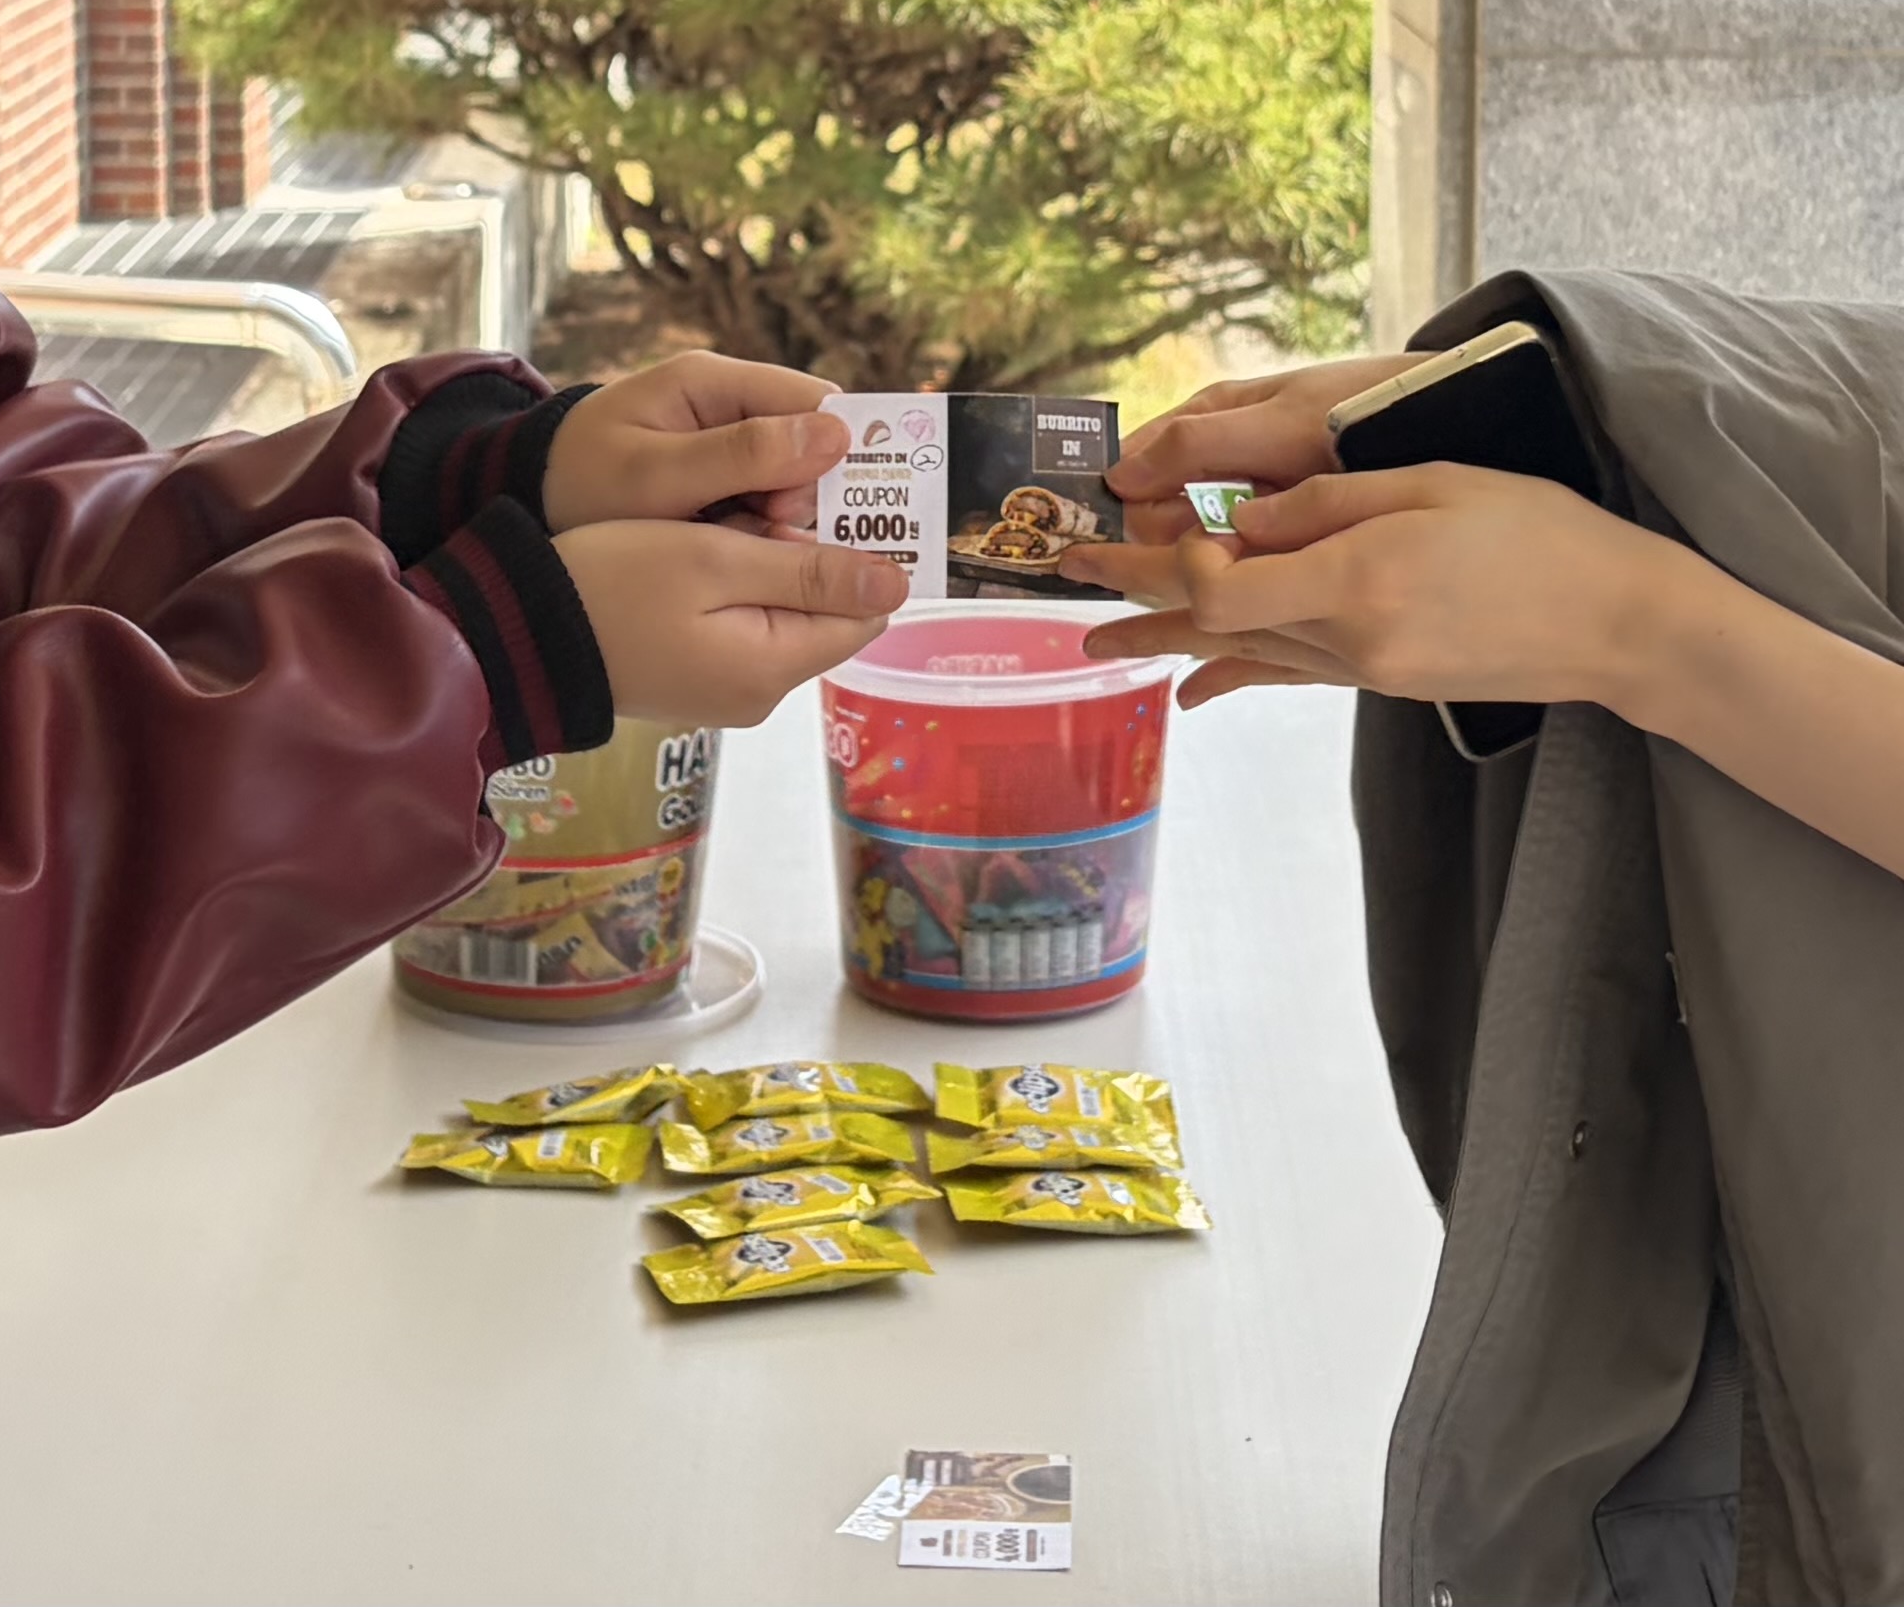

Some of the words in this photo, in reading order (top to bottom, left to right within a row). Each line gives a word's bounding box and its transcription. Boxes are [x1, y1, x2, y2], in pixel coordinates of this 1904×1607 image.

[1037, 414, 1102, 432] BURRITO
[1062, 440, 1081, 456] IN
[844, 487, 909, 507] COUPON
